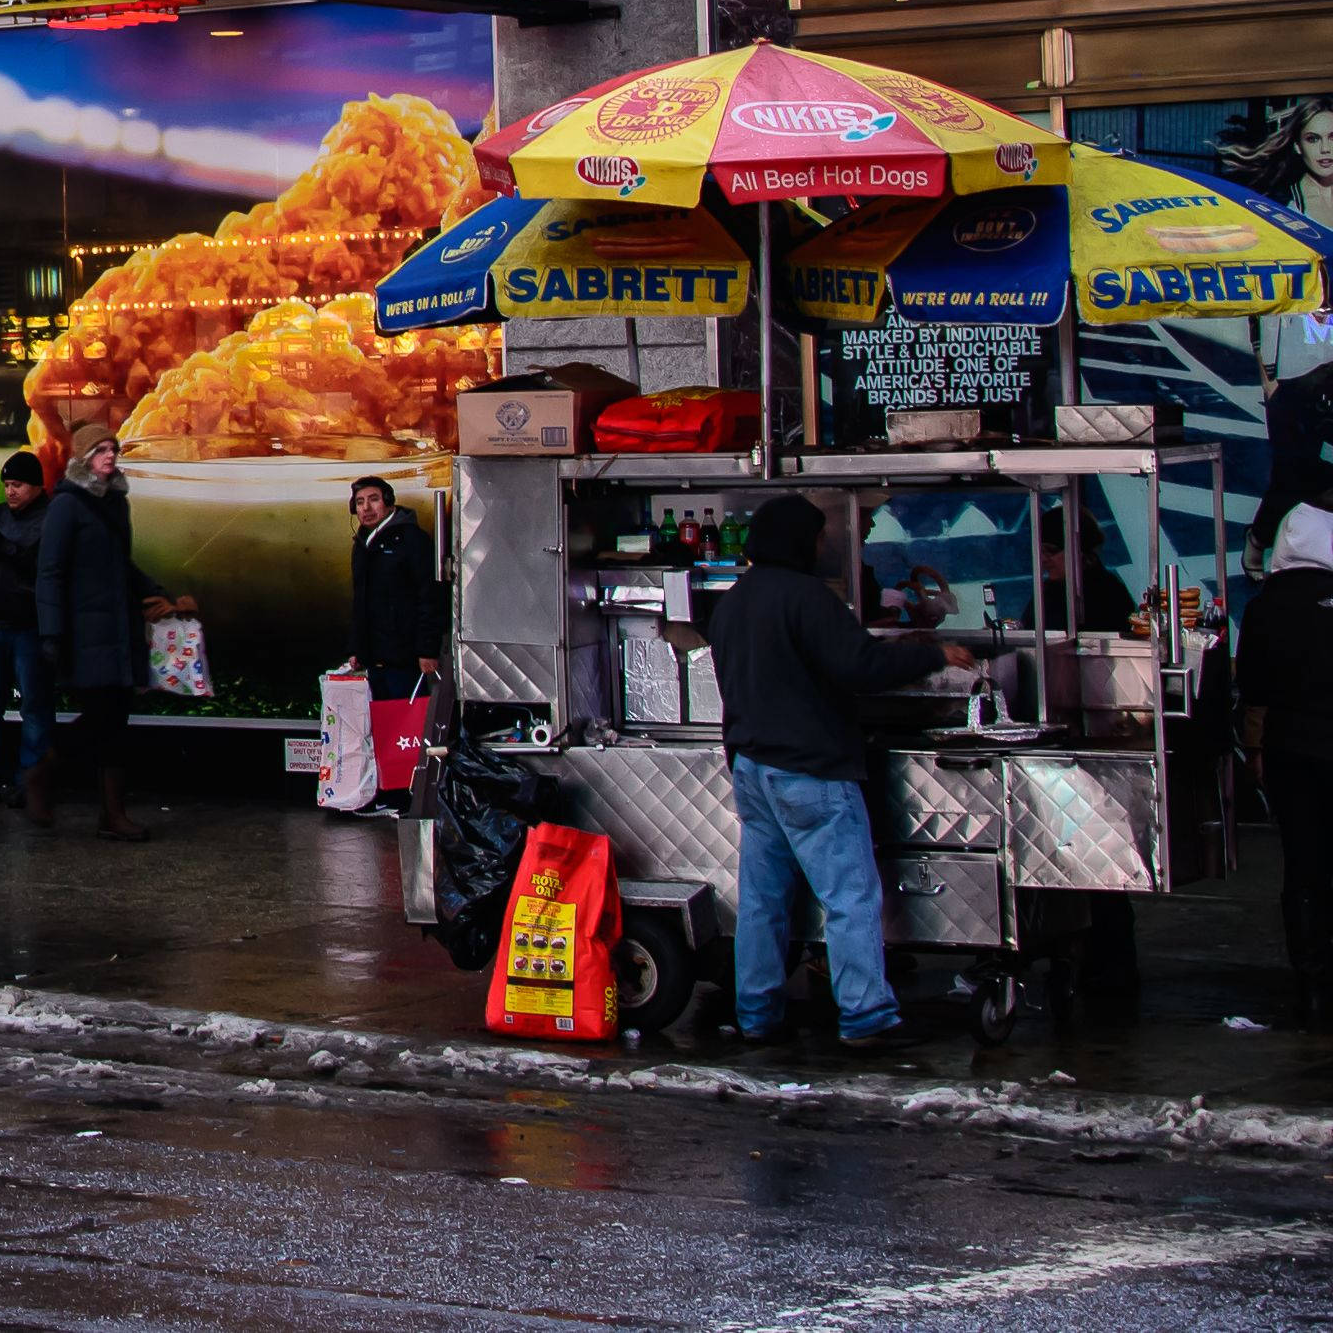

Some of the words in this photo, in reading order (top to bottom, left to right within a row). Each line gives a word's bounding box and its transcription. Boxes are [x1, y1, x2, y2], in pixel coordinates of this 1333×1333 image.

[751, 104, 860, 131] NIKAS
[584, 156, 633, 184] NIKAS
[731, 170, 758, 193] All
[764, 166, 816, 190] Beef
[823, 165, 862, 188] Hot
[869, 164, 930, 190] Dogs
[1089, 194, 1221, 234] SABRETT
[505, 268, 739, 305] SABRETT
[1087, 260, 1313, 310] SABRETT
[386, 299, 414, 317] WE'RE
[416, 296, 429, 310] ON
[430, 295, 439, 309] A
[441, 292, 464, 307] ROLL
[902, 292, 946, 306] WE'RE
[950, 292, 972, 306] ON
[974, 292, 985, 306] A
[989, 292, 1025, 306] ROLL
[842, 329, 915, 345] MARKED
[919, 328, 941, 343] BY
[946, 325, 1041, 342] INDIVIDUAL
[842, 345, 895, 360] STYLE
[899, 344, 911, 359] &
[915, 340, 1042, 358] UNTOUCHABLE
[865, 358, 950, 374] ATTITUDE.
[954, 357, 990, 372] ONE
[994, 356, 1018, 372] OF
[854, 373, 946, 390] AMERICA'S
[950, 372, 1031, 388] FAVORITE
[868, 389, 938, 405] BRANDS
[942, 388, 978, 404] HAS
[983, 387, 1023, 403] JUST
